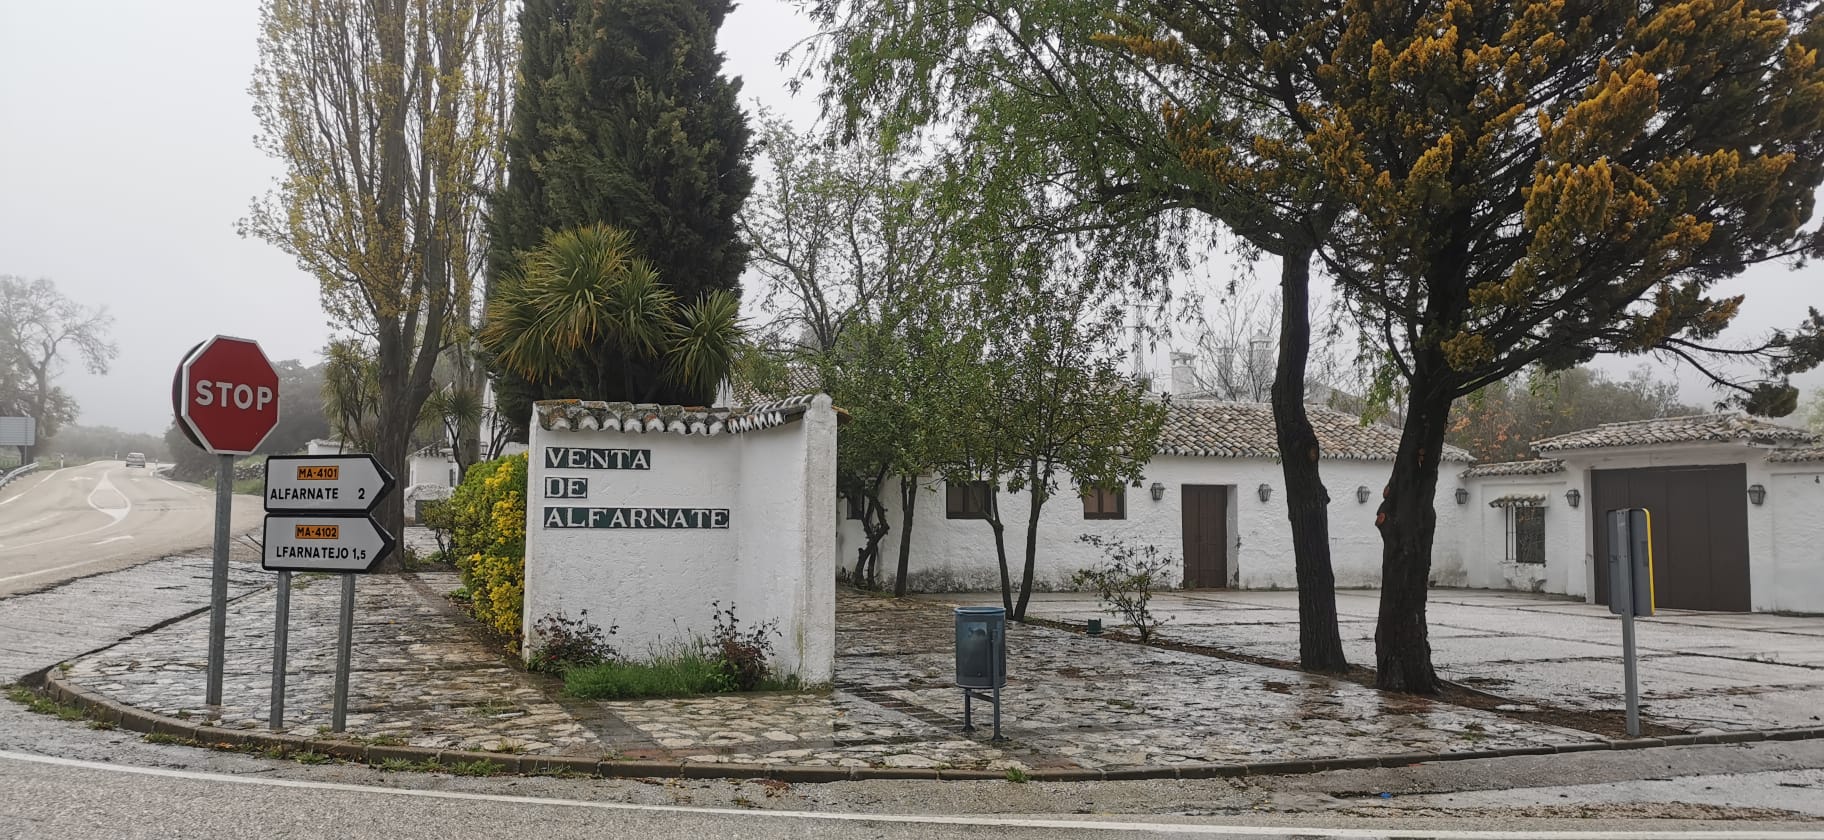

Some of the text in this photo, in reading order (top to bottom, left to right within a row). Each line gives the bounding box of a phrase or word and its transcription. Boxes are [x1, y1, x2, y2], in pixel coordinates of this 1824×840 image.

[195, 380, 273, 411] STOP
[546, 448, 650, 469] VENTA
[298, 467, 337, 478] MA-4101
[270, 488, 365, 500] ALFARNATE 2
[545, 478, 587, 498] DE
[545, 508, 729, 529] ALFARNATE
[296, 526, 337, 538] MA-4102
[276, 546, 366, 560] LFARNATEJO 1,5
